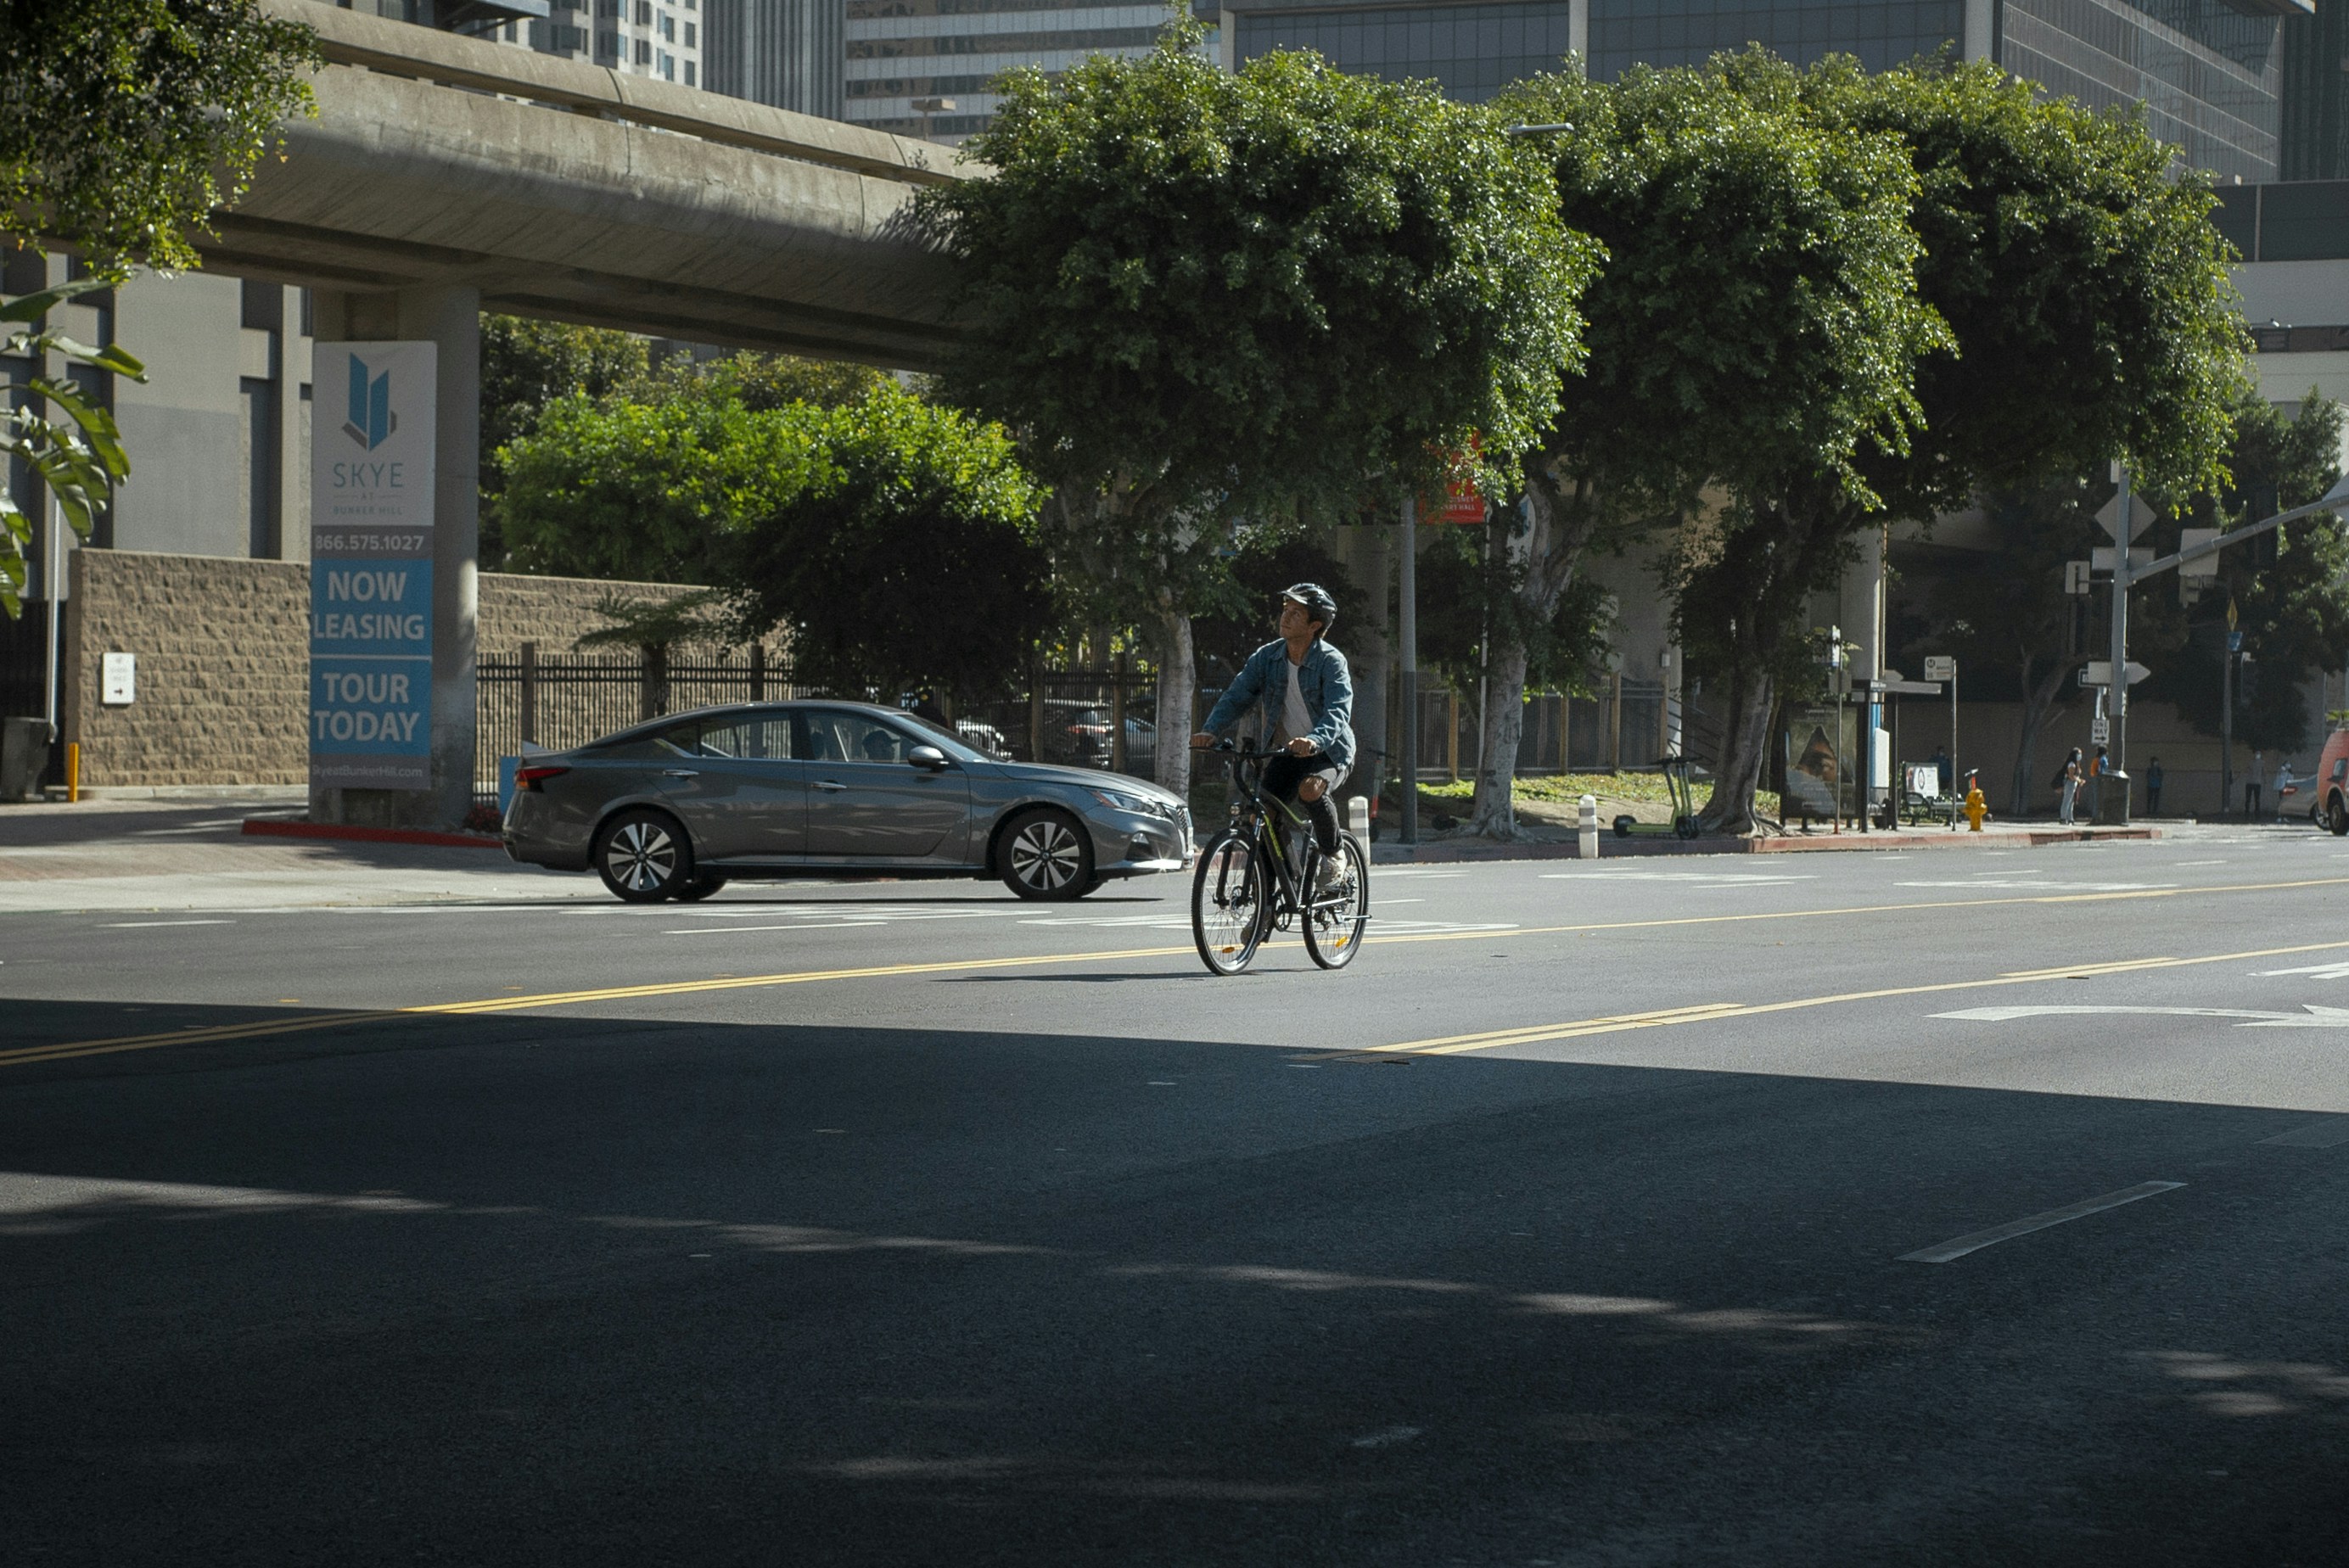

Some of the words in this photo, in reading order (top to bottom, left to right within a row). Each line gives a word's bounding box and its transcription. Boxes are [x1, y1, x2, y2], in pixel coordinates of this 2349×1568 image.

[334, 462, 403, 488] SKYE
[334, 506, 375, 515] BUNKER
[378, 506, 402, 515] HILL
[315, 535, 423, 551] 866.575.1027
[328, 571, 406, 602] NOW
[313, 613, 424, 640] LEASING
[322, 672, 409, 703] TOUR
[313, 711, 420, 742] TODAY
